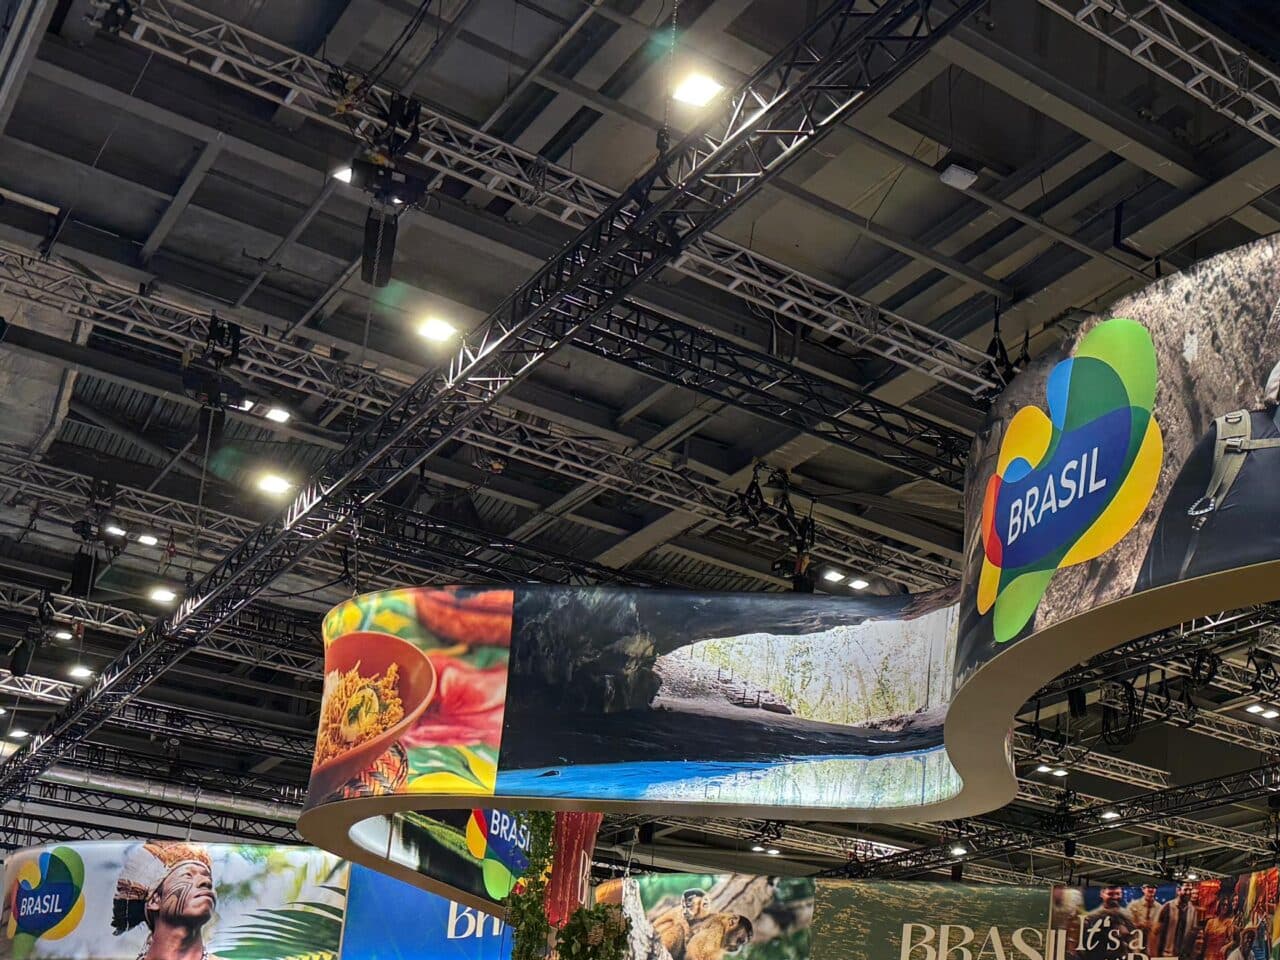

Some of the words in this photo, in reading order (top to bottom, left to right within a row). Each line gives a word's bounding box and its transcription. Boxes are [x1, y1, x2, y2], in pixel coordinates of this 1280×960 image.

[1007, 446, 1107, 546] BRASIL
[489, 808, 532, 852] BRASI
[20, 894, 62, 916] BRASIL
[1128, 928, 1146, 950] a
